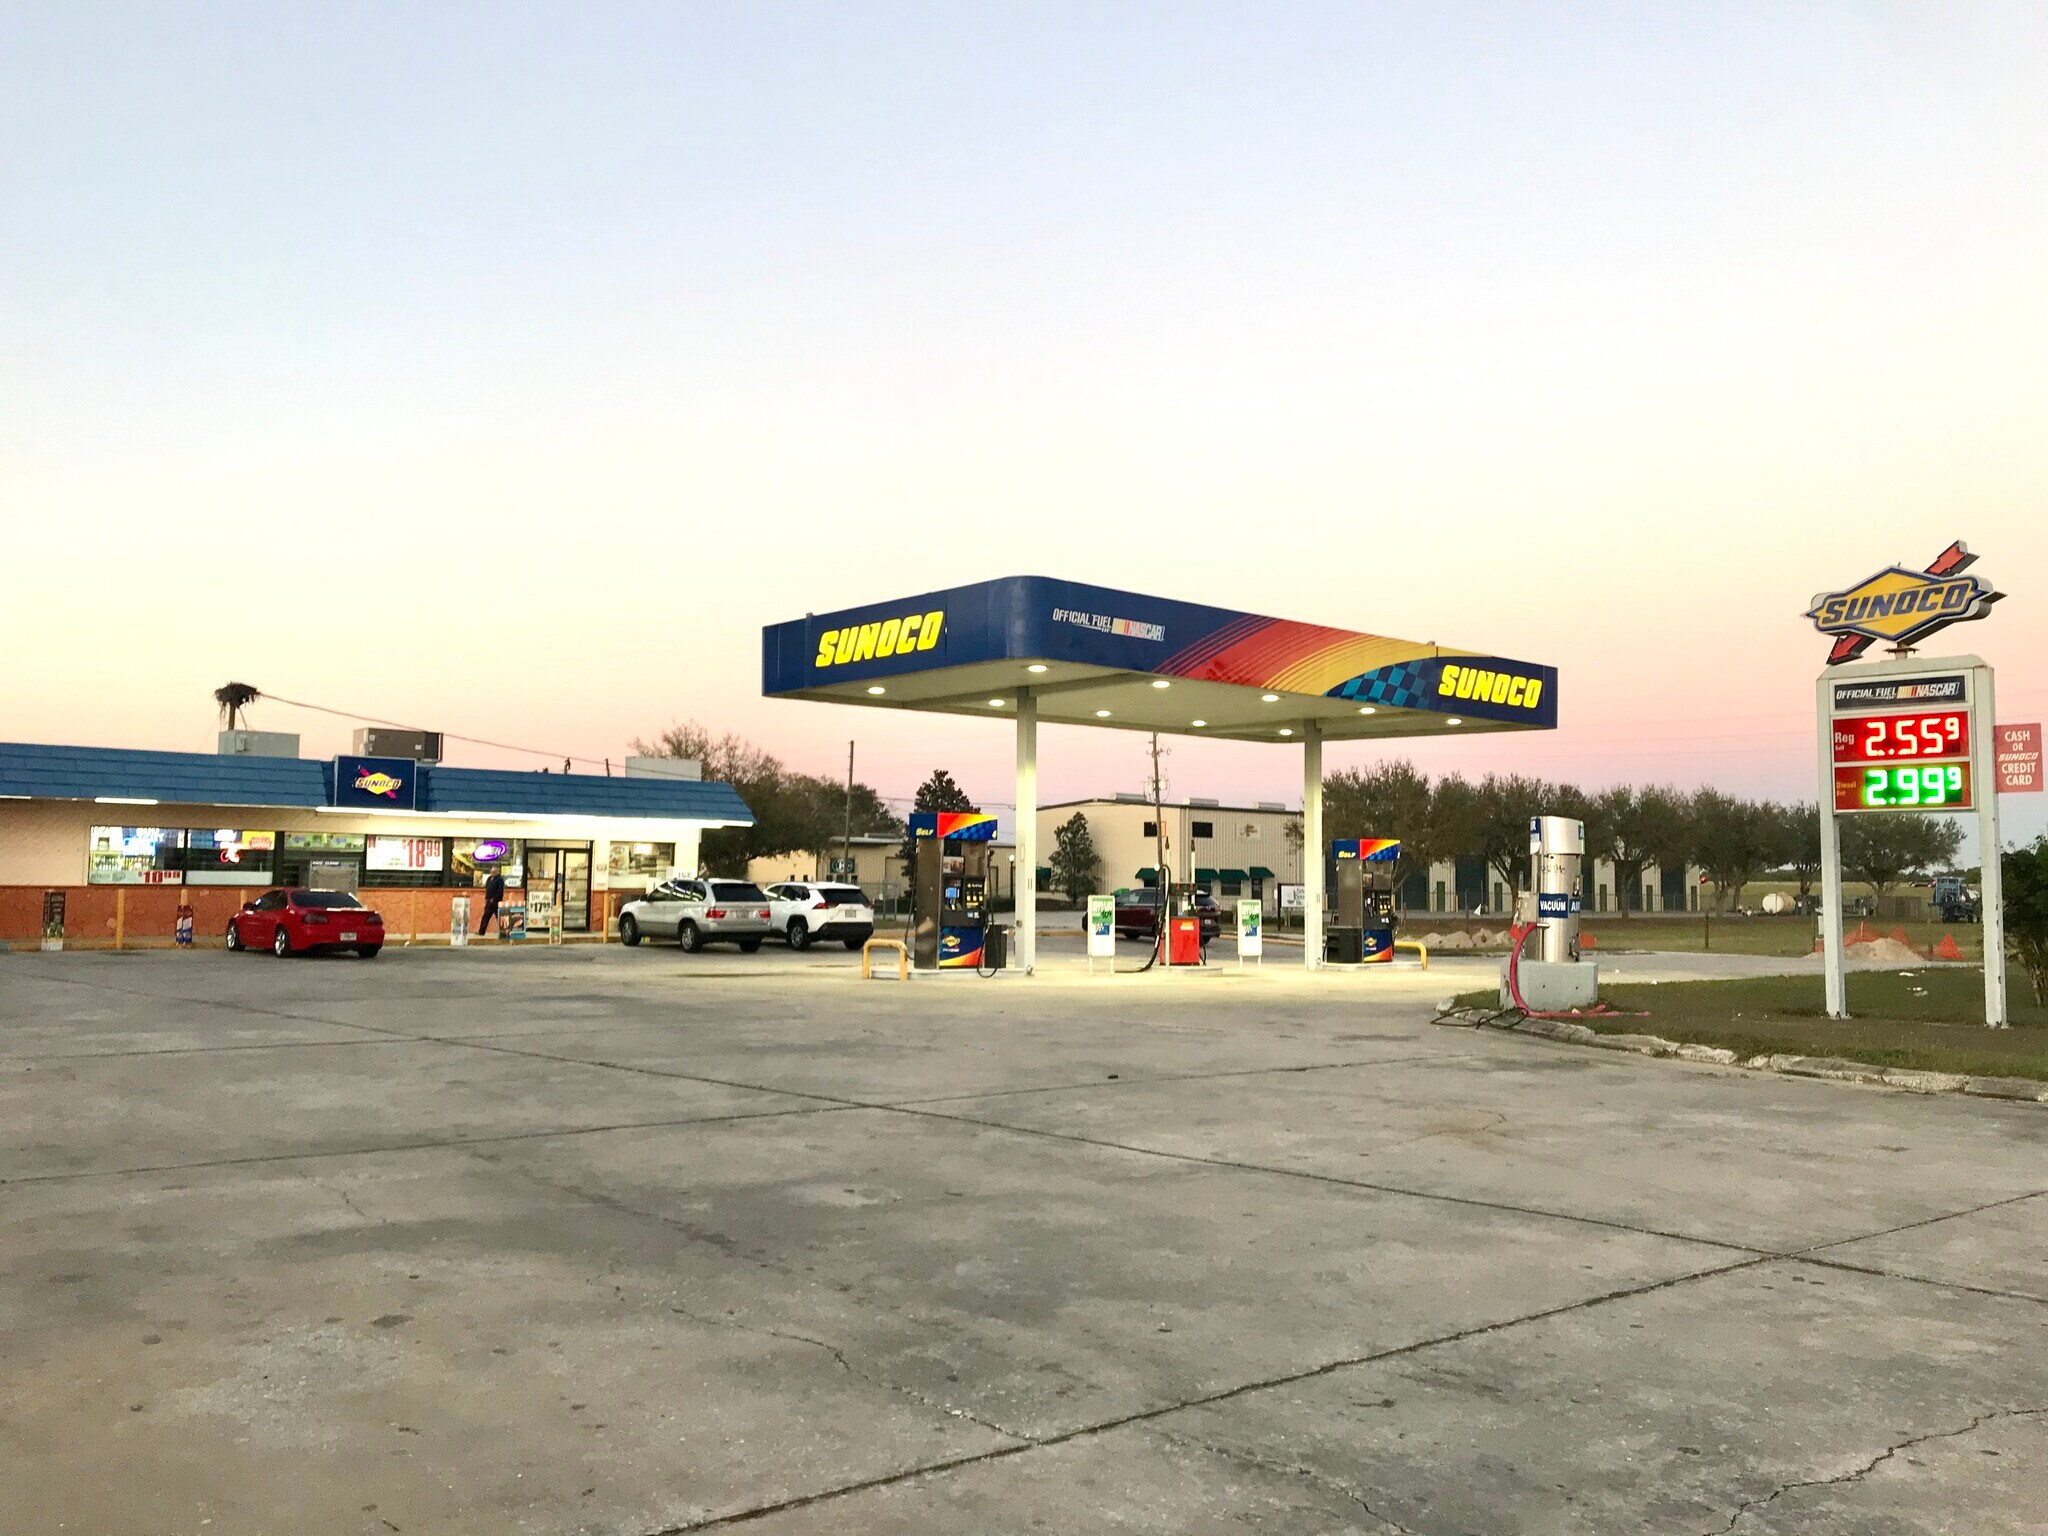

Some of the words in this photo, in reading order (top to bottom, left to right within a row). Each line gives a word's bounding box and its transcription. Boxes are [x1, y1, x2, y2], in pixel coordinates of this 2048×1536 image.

[1821, 582, 1971, 625] SUNOCO
[1052, 607, 1091, 626] OFFICIAL
[1091, 614, 1112, 628] FUEL
[1128, 620, 1165, 641] NASCAR
[814, 610, 945, 668] SUNOCO
[1437, 664, 1543, 709] SUNOCO
[1836, 688, 1874, 700] OFFICIAL
[1875, 686, 1897, 698] FUEL
[1916, 681, 1960, 698] NASCAR
[1834, 732, 1855, 745] Reg
[2004, 730, 2031, 742] CASH
[2012, 742, 2024, 752] OR
[1997, 752, 2039, 761] SUNOCO
[2001, 761, 2036, 774] CREDIT
[356, 779, 400, 789] SUNOCO
[2005, 774, 2033, 786] CARD
[1540, 900, 1567, 912] VACUUM
